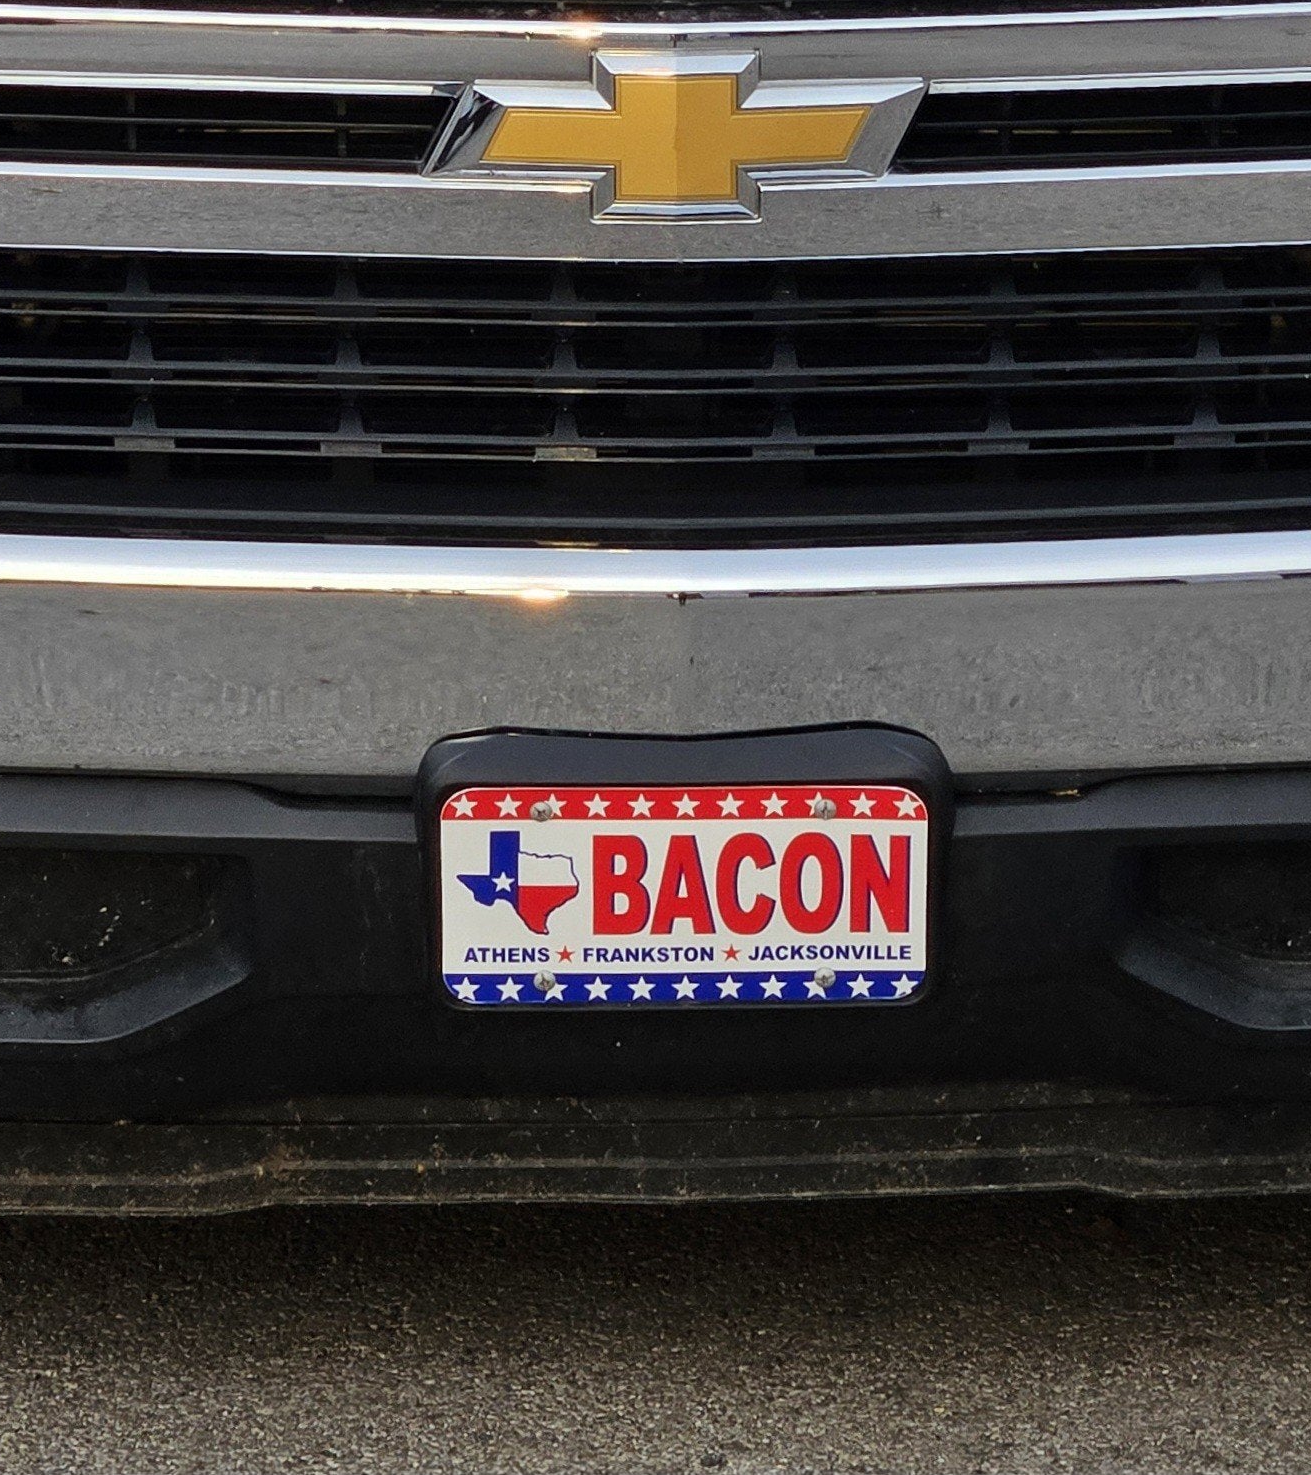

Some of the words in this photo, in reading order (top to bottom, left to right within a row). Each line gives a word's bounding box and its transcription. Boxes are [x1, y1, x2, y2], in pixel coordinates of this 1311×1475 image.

[592, 832, 911, 935] BACON
[463, 945, 551, 964] ATHENS
[582, 945, 715, 963] FRANKSTON
[747, 943, 912, 962] JACKSONVILLE
